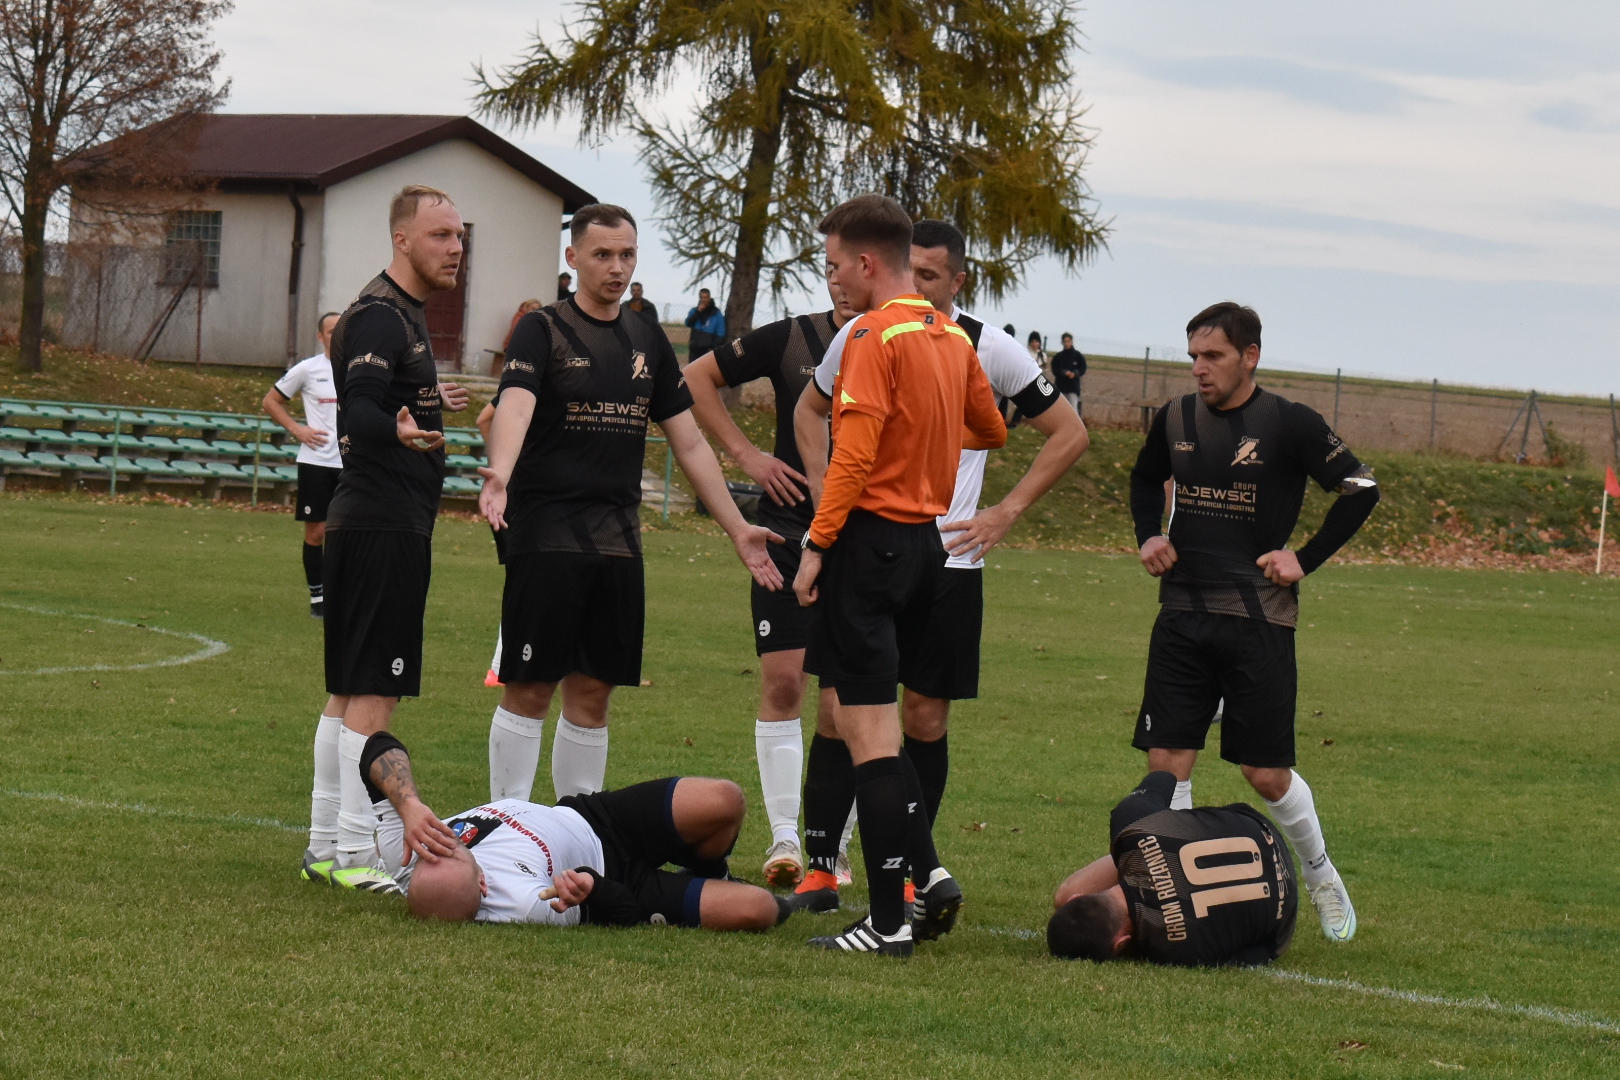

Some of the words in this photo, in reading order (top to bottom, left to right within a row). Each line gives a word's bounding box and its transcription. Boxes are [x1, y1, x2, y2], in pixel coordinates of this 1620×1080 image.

[1176, 483, 1256, 503] SAJEWSKI
[1179, 836, 1271, 919] 10
[1161, 901, 1187, 942] GROM
